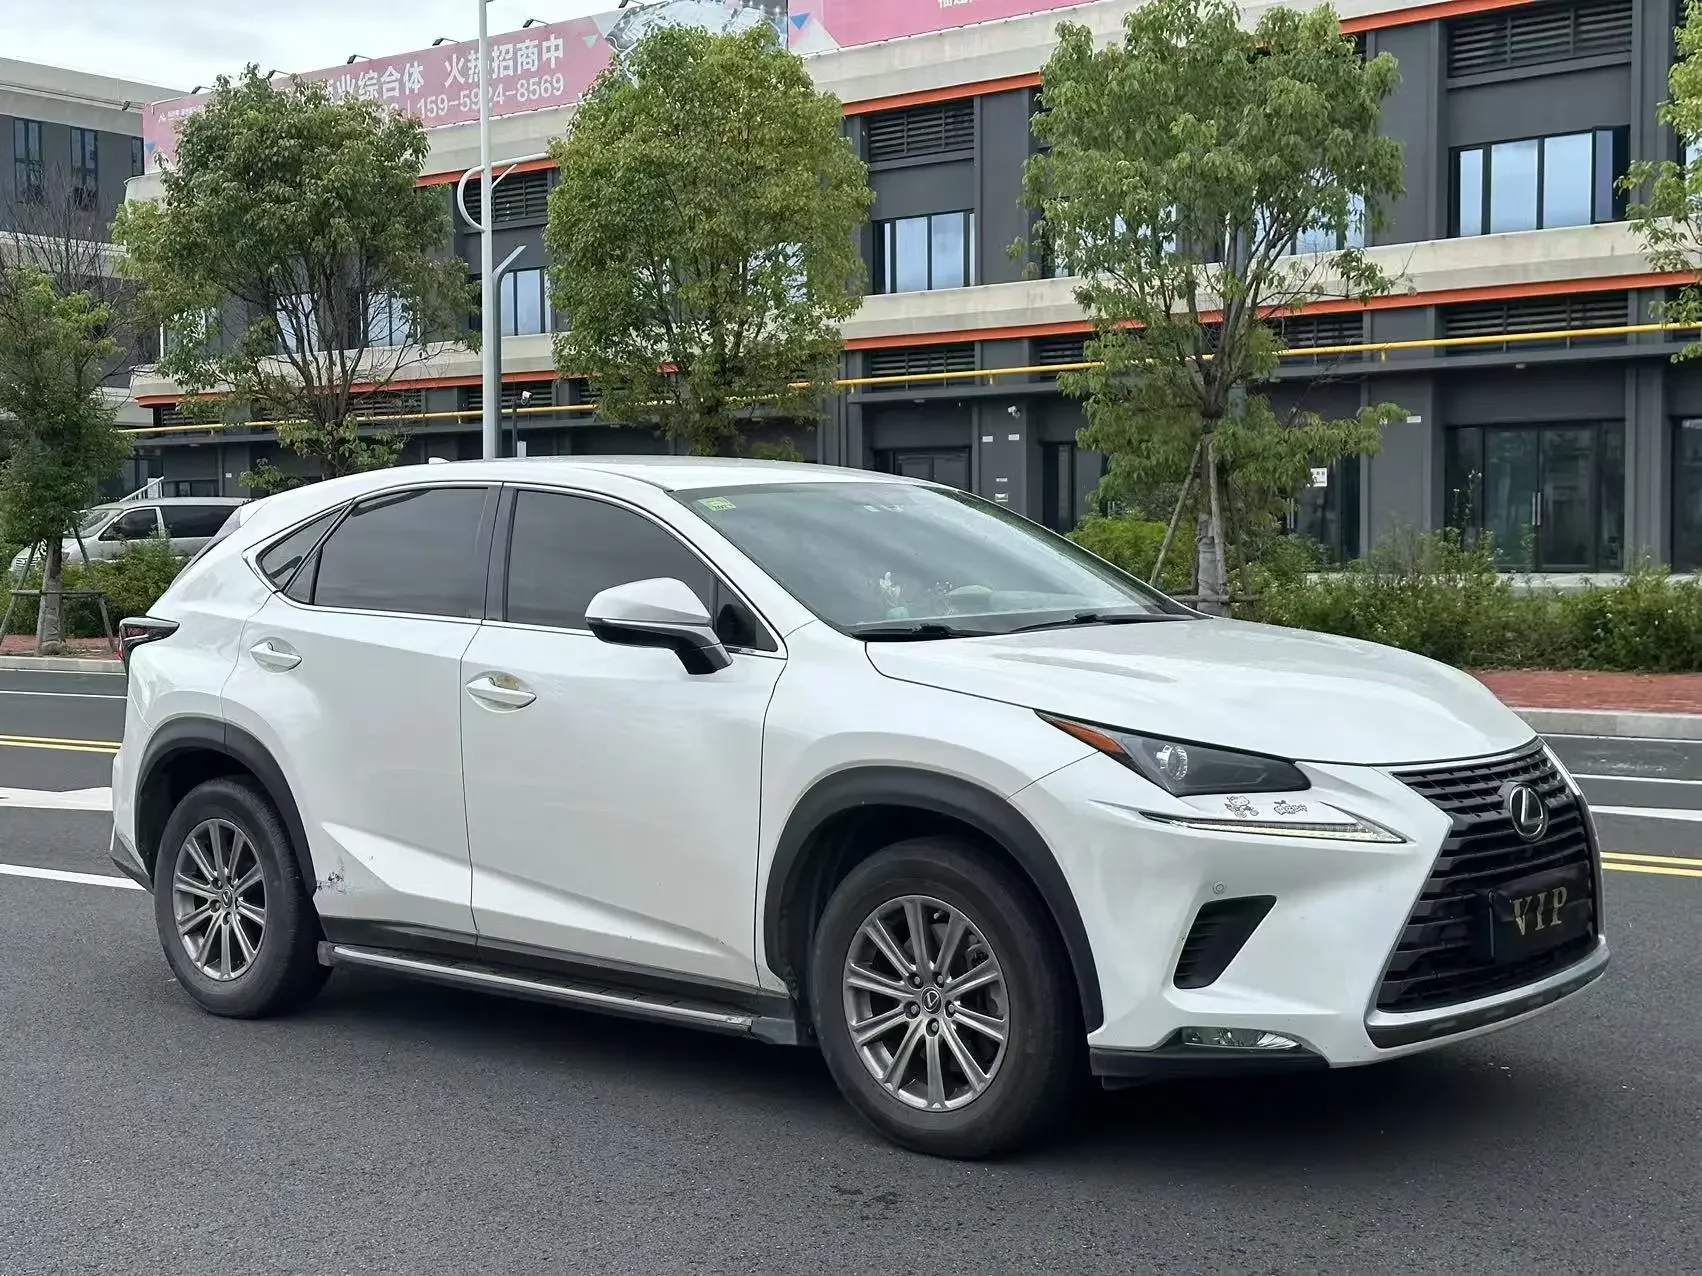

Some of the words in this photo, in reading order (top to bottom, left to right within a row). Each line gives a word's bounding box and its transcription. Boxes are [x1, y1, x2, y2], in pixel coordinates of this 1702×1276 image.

[326, 61, 424, 103] 业综合体
[1512, 886, 1568, 936] VIP
